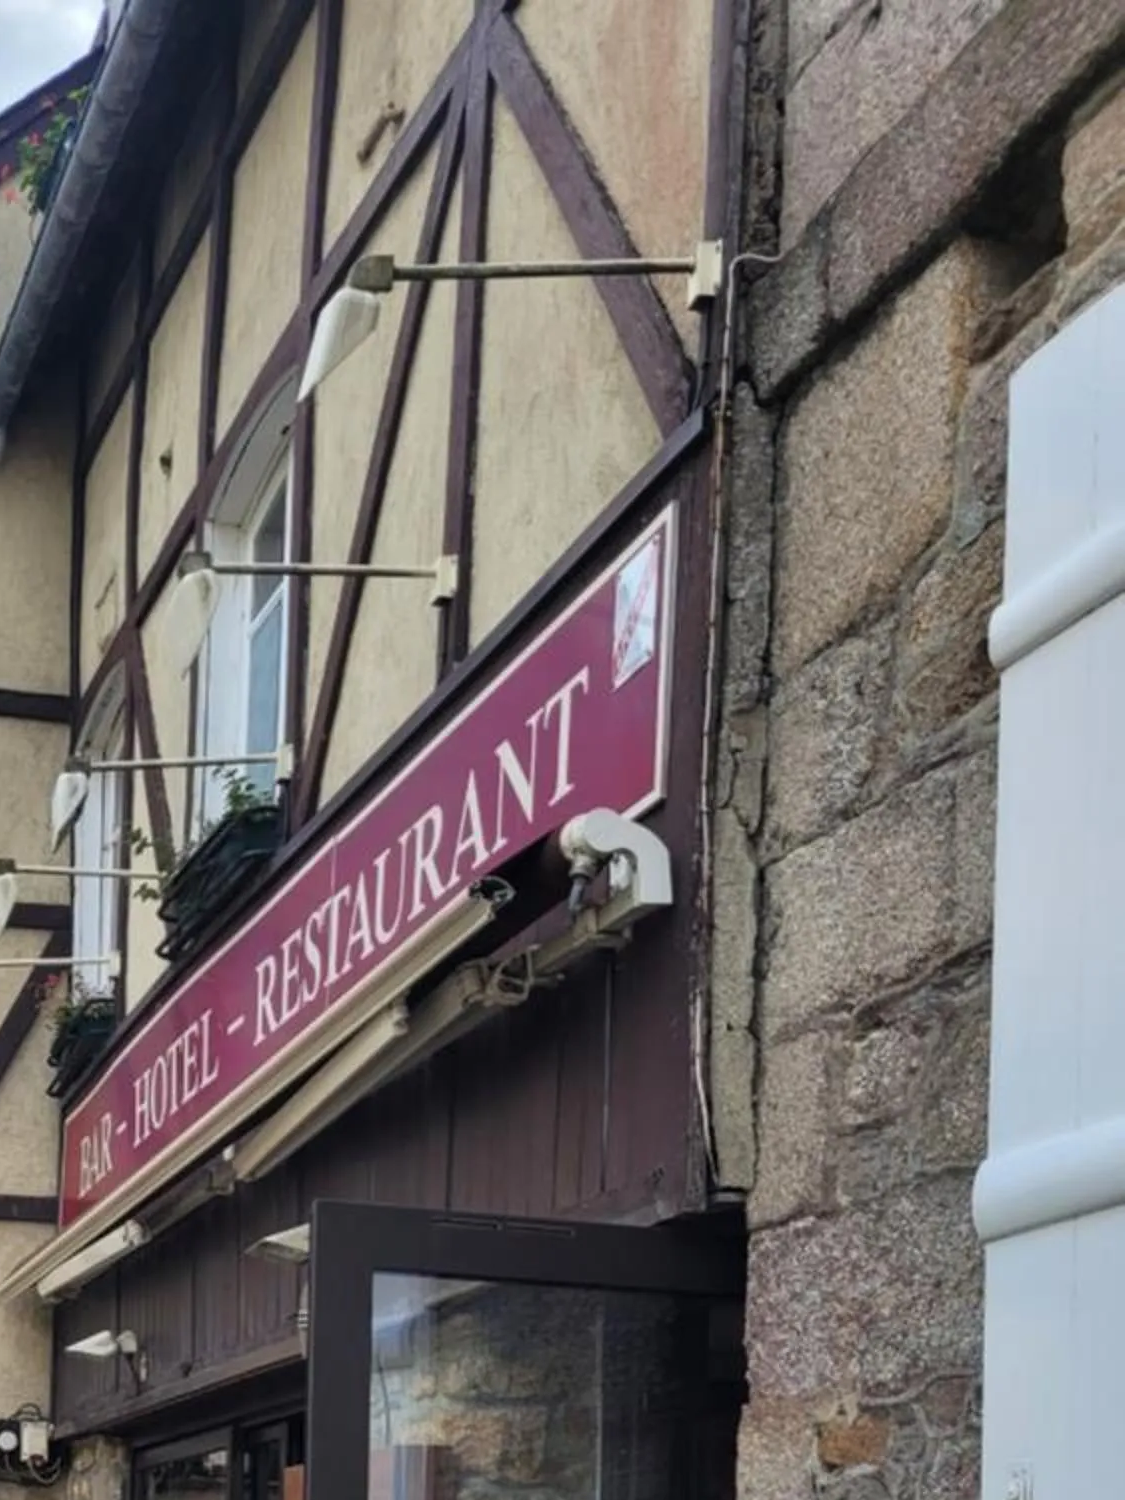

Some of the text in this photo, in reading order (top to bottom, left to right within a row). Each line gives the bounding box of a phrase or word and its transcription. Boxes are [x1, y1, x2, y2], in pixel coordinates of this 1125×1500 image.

[77, 1112, 113, 1200] BAR
[132, 1008, 221, 1149] HOTEL
[252, 664, 590, 1047] RESTAURANT
